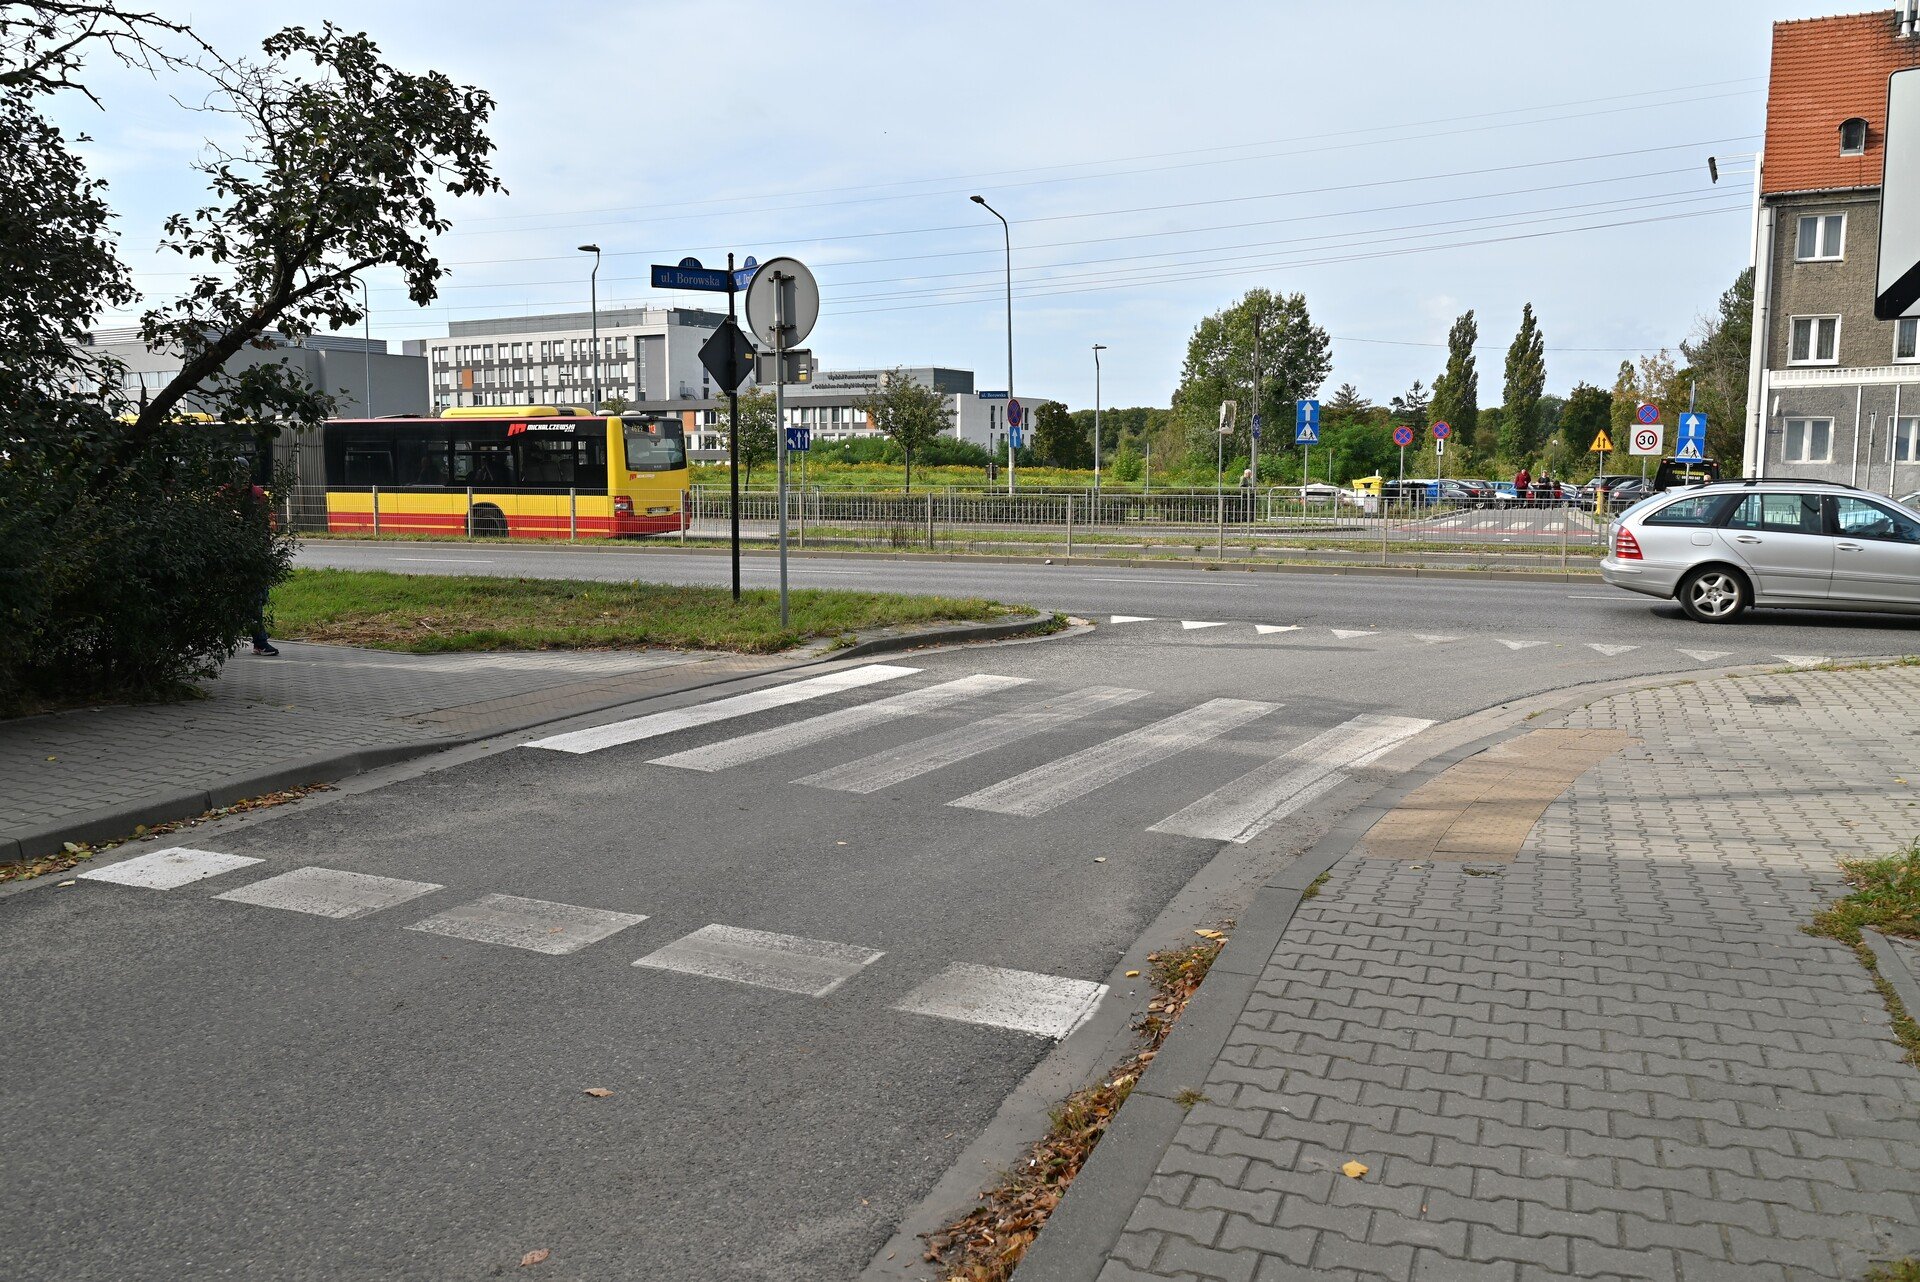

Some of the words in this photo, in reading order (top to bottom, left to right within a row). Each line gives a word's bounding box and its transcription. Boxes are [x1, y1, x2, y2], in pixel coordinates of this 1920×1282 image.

[661, 272, 673, 283] ul.
[677, 273, 720, 286] Borowska
[1638, 435, 1655, 445] 30
